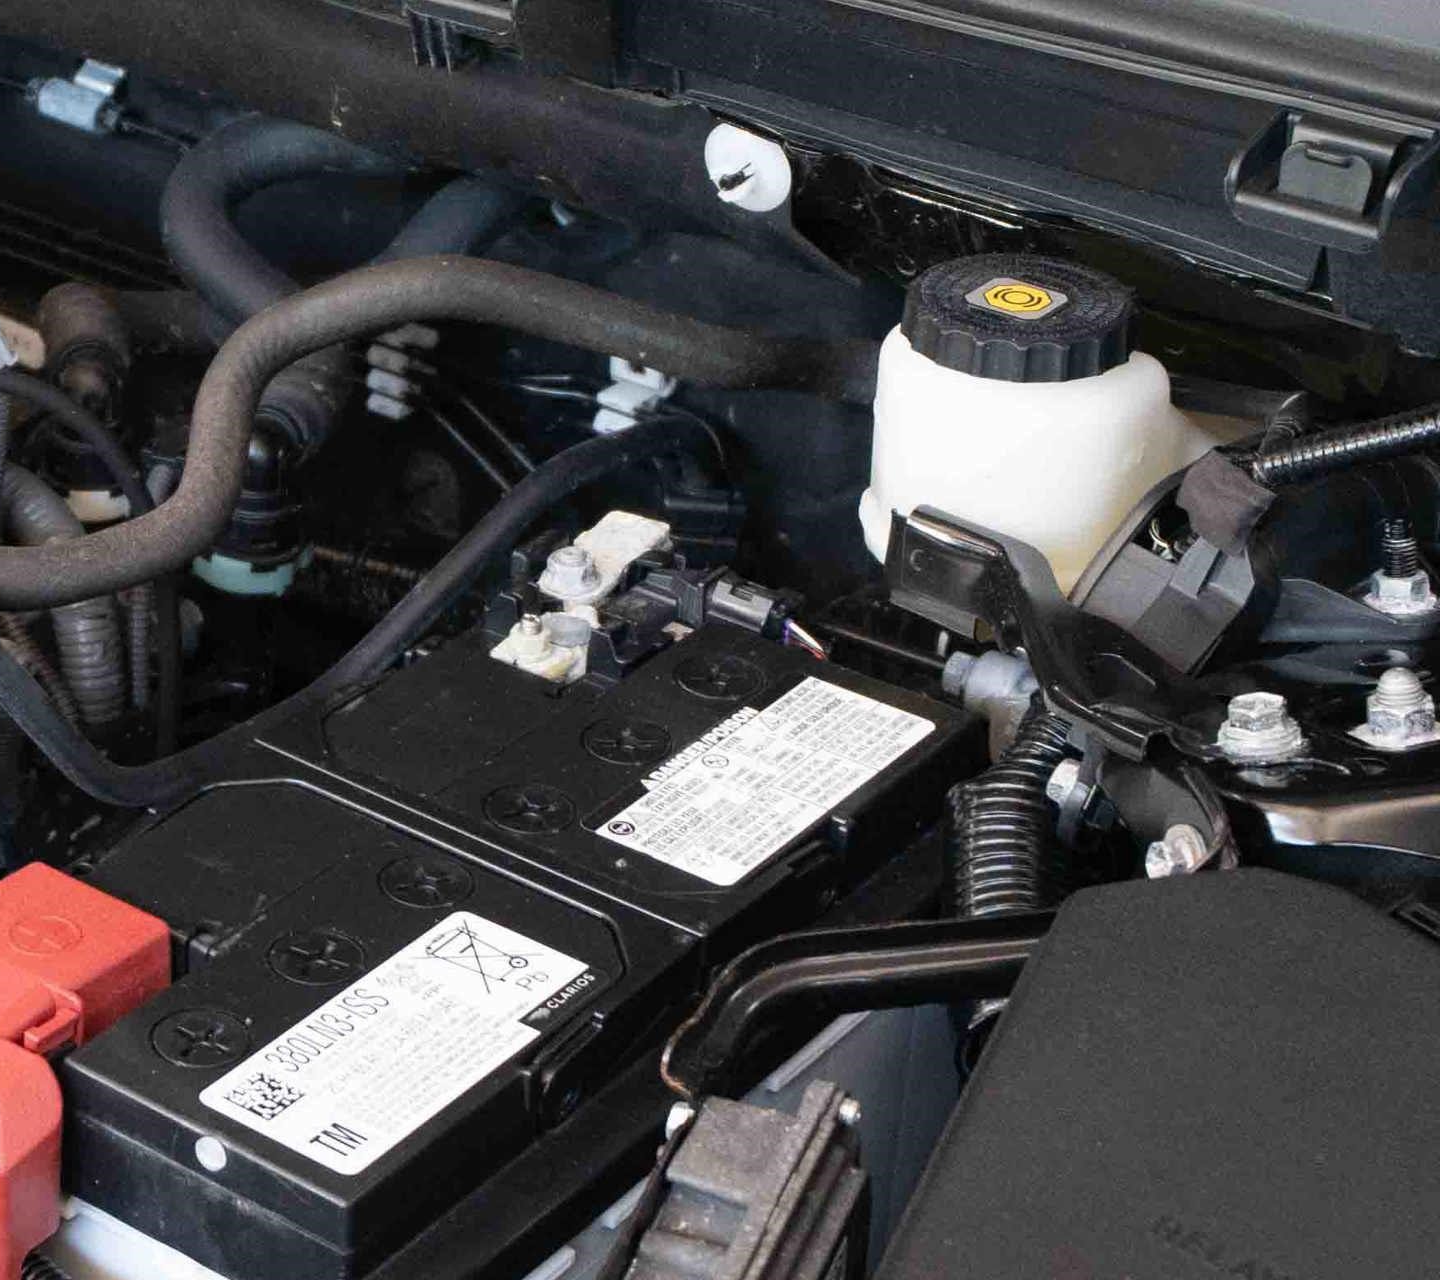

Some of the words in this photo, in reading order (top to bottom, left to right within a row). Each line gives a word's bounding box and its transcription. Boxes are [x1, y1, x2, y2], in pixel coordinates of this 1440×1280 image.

[515, 971, 550, 992] Pb
[546, 972, 596, 1009] CLARIOS
[264, 987, 390, 1073] 380LN3-ISS
[309, 1122, 369, 1157] TM
